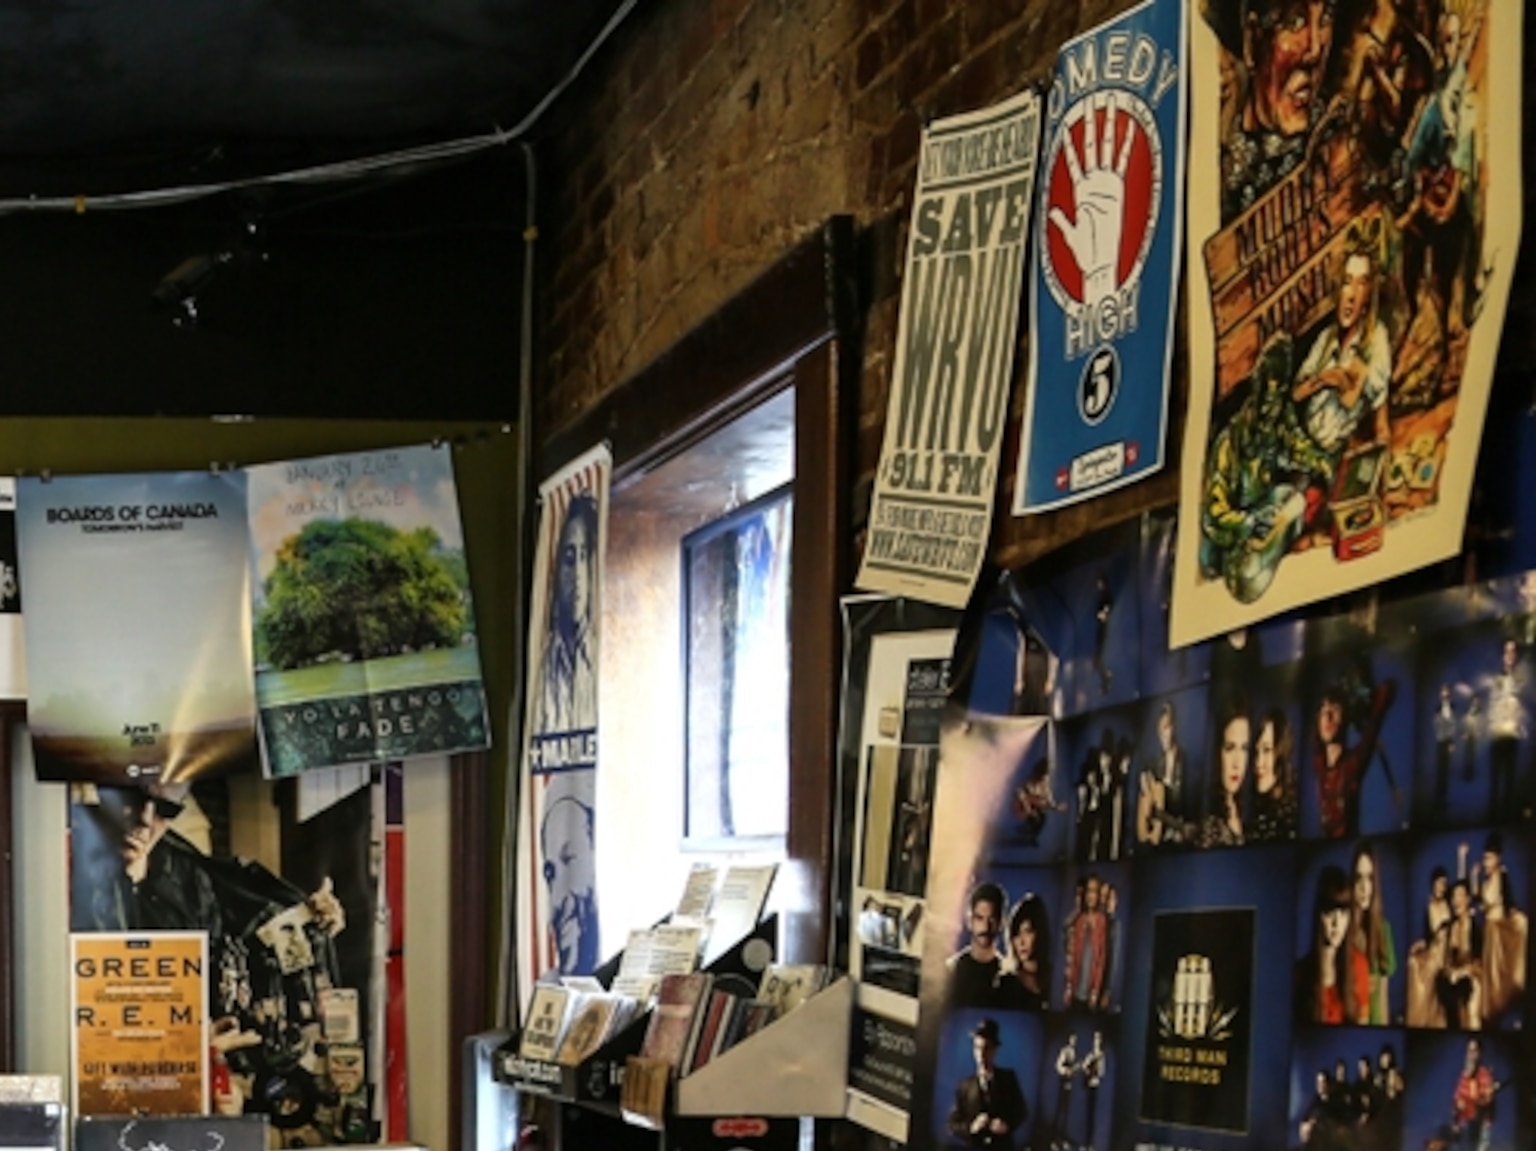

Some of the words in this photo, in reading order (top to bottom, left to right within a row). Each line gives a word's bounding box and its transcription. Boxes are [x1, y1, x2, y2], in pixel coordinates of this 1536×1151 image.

[914, 179, 1027, 257] SAVE
[1066, 285, 1139, 361] HIGH
[897, 244, 1021, 454] WRVU
[1083, 352, 1114, 415] 5
[937, 454, 986, 496] FM
[47, 506, 114, 523] BOARDS
[119, 506, 142, 520] OF
[146, 503, 218, 519] CANADA
[285, 709, 317, 725] YO
[332, 703, 363, 719] LA
[376, 688, 460, 713] TENGO
[336, 715, 413, 741] FADE
[76, 957, 202, 979] GREEN
[76, 1006, 105, 1027] R.
[122, 1005, 155, 1027] E.
[170, 1005, 202, 1027] M.
[1158, 1046, 1192, 1062] THIRD
[1196, 1049, 1227, 1065] MAN
[1161, 1065, 1221, 1084] RECORDS
